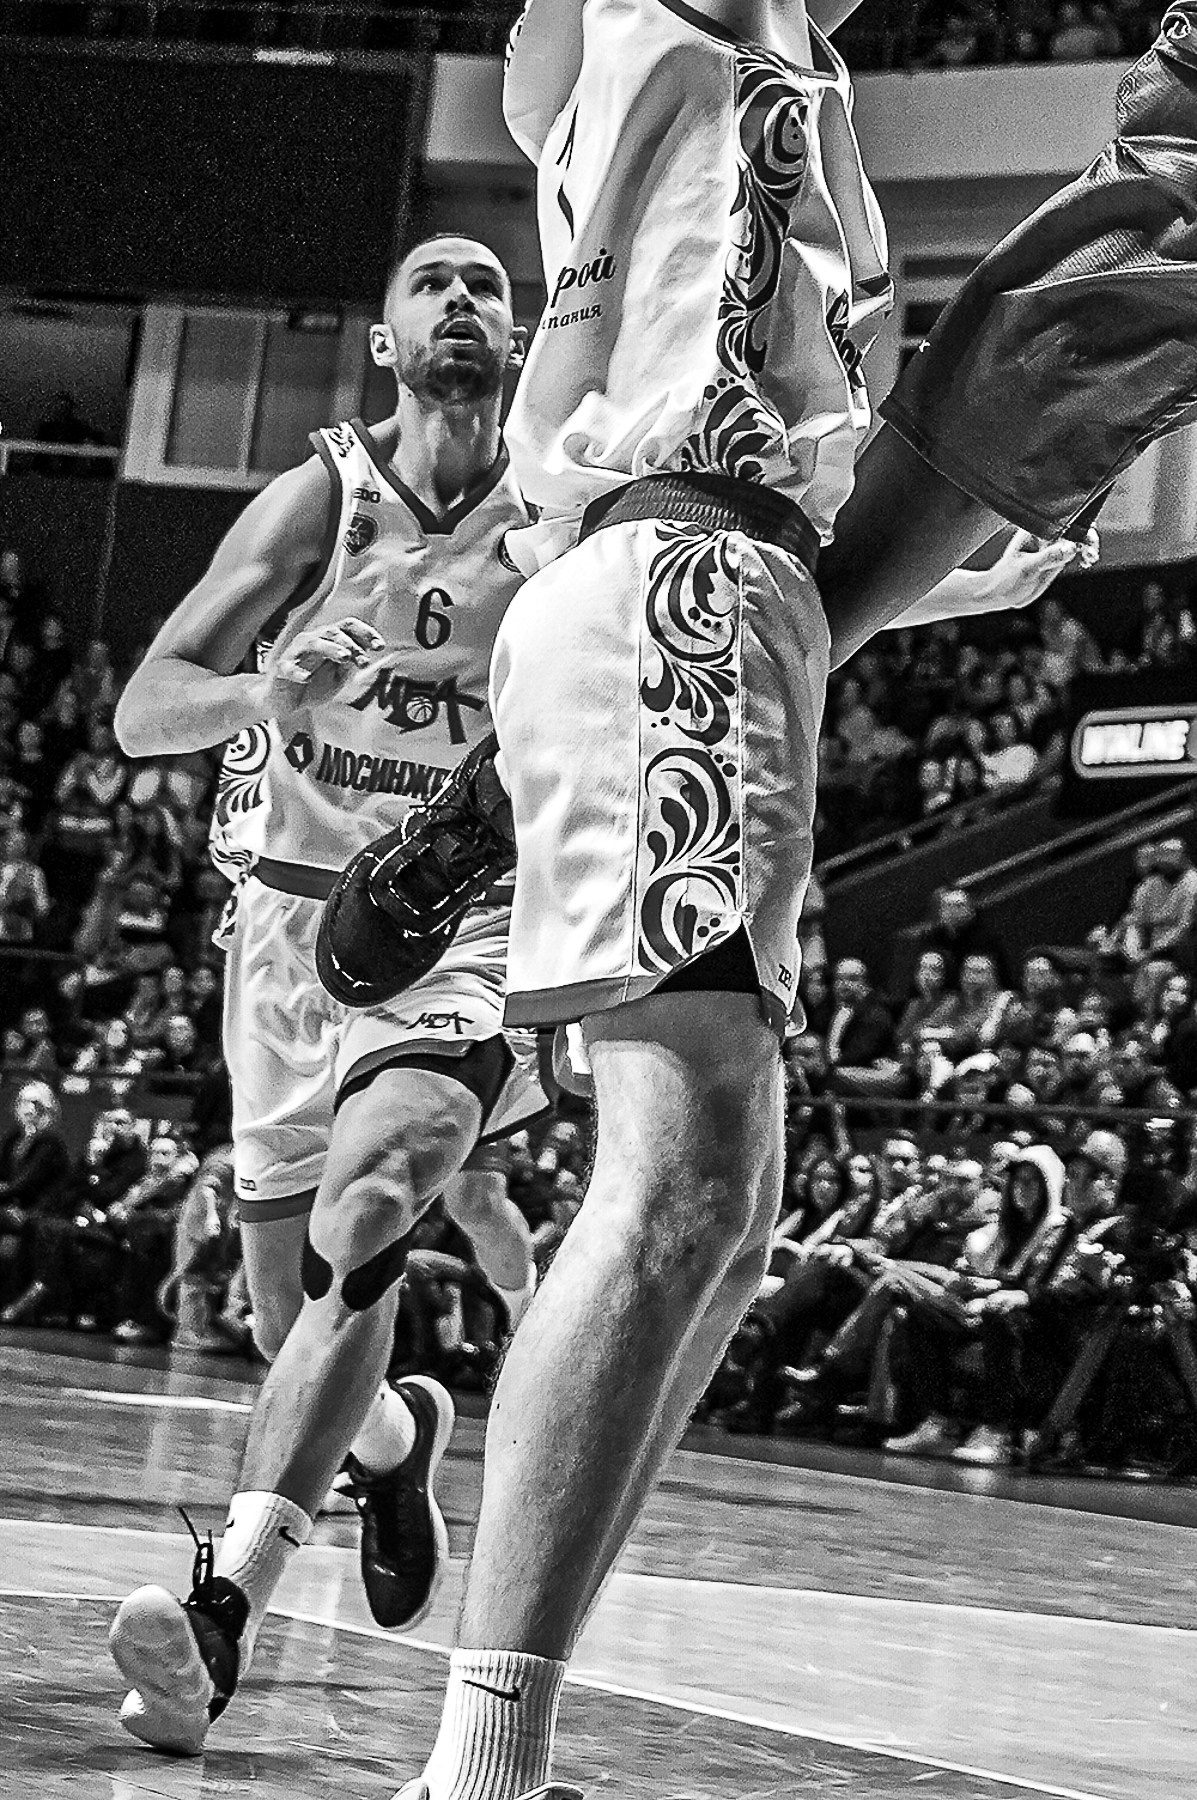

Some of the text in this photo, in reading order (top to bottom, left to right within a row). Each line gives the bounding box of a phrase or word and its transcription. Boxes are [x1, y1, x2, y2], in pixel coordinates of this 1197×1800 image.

[550, 247, 617, 309] рой
[541, 303, 603, 330] пания
[353, 487, 382, 504] EDO
[414, 587, 455, 651] 6
